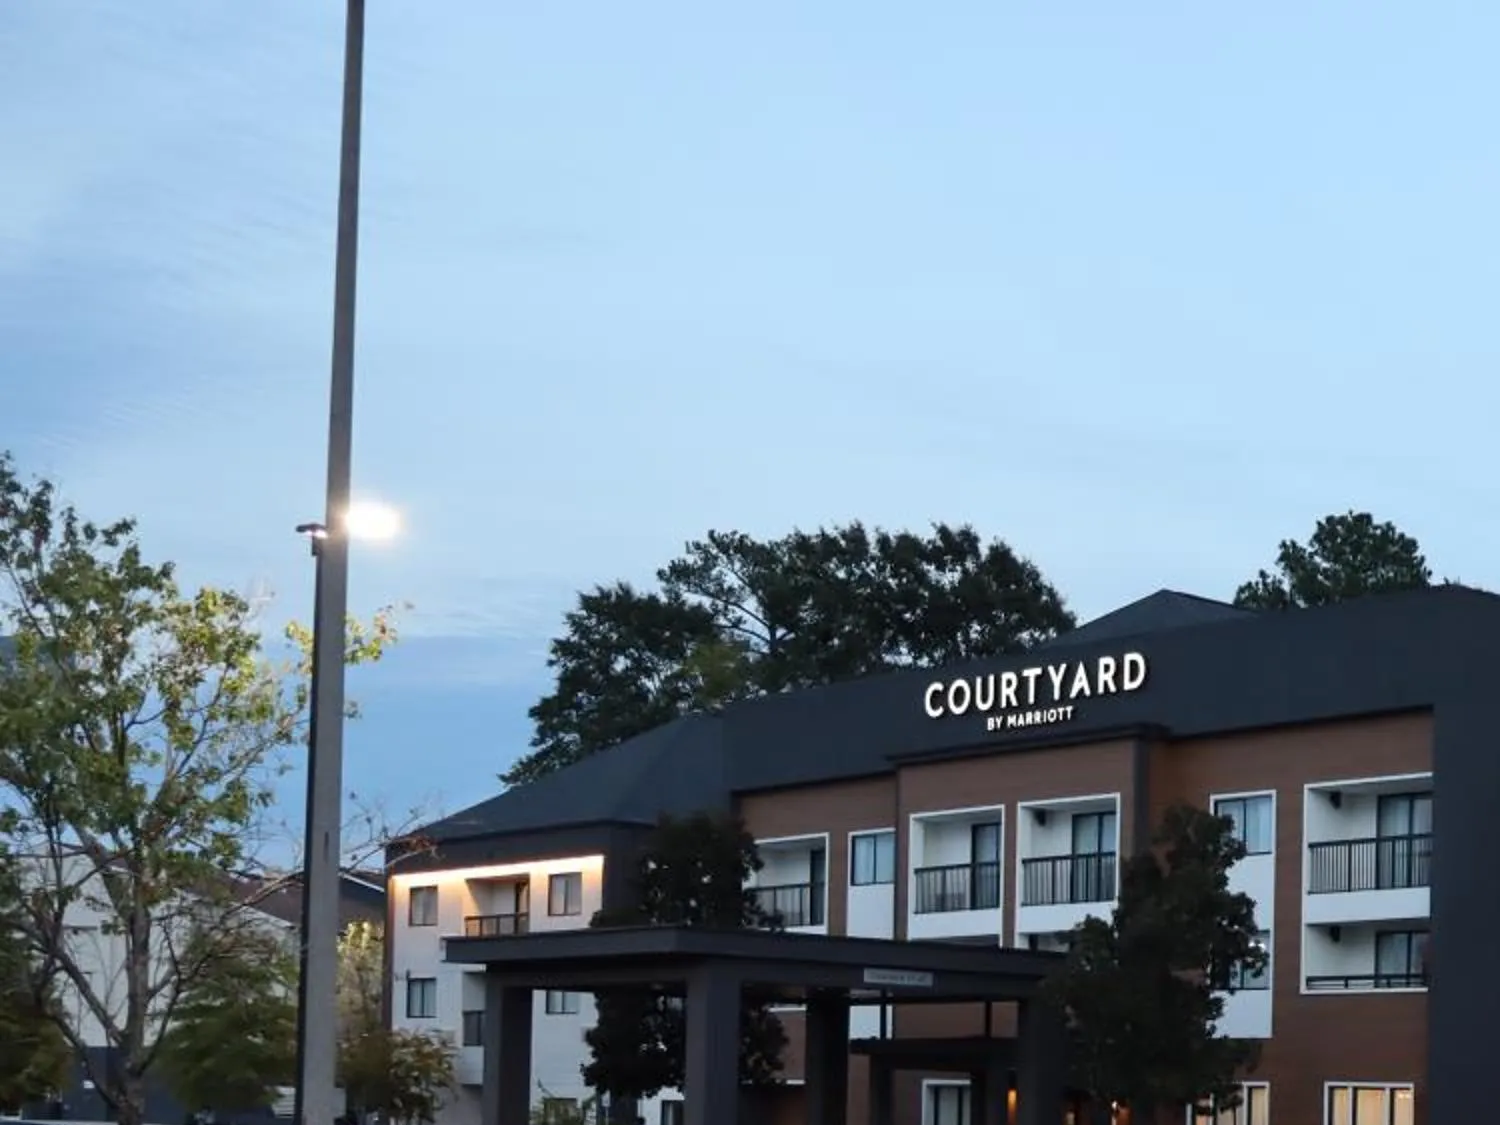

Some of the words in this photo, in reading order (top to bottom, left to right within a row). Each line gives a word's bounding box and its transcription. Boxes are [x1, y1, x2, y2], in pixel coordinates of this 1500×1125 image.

[924, 652, 1146, 717] COURTYARD
[987, 715, 1003, 731] BY
[1007, 705, 1074, 729] MARRIOTT
